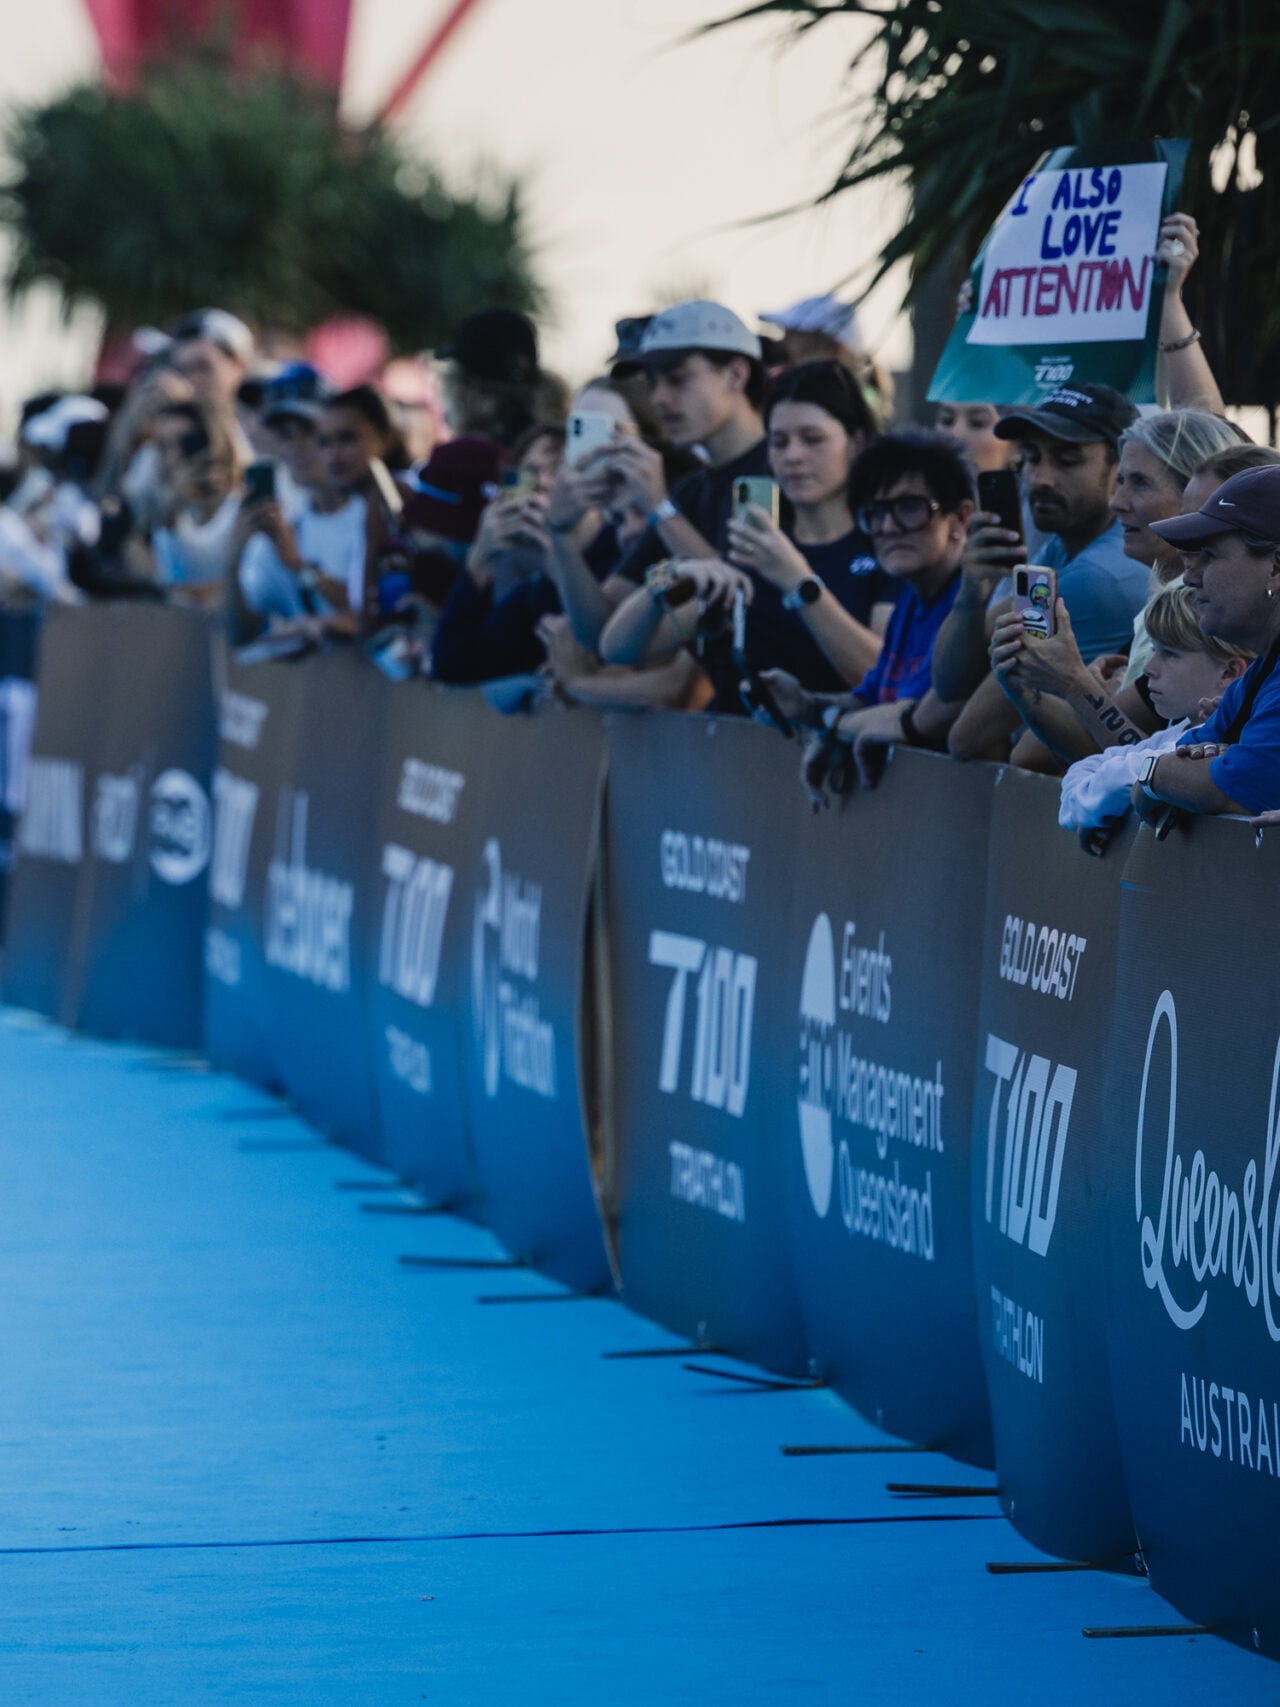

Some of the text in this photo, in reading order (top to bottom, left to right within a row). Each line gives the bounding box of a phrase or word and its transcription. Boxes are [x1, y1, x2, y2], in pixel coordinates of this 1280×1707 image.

[1012, 168, 1122, 216] I ALSO
[1041, 211, 1122, 260] LOVE
[660, 828, 751, 903] GOLD COAST
[839, 920, 893, 1024] Events
[1000, 914, 1087, 1002] GOLD COAST
[649, 929, 758, 1119] T100
[836, 1030, 945, 1161] Management
[984, 1033, 1078, 1258] T100
[838, 1138, 935, 1262] Queensland
